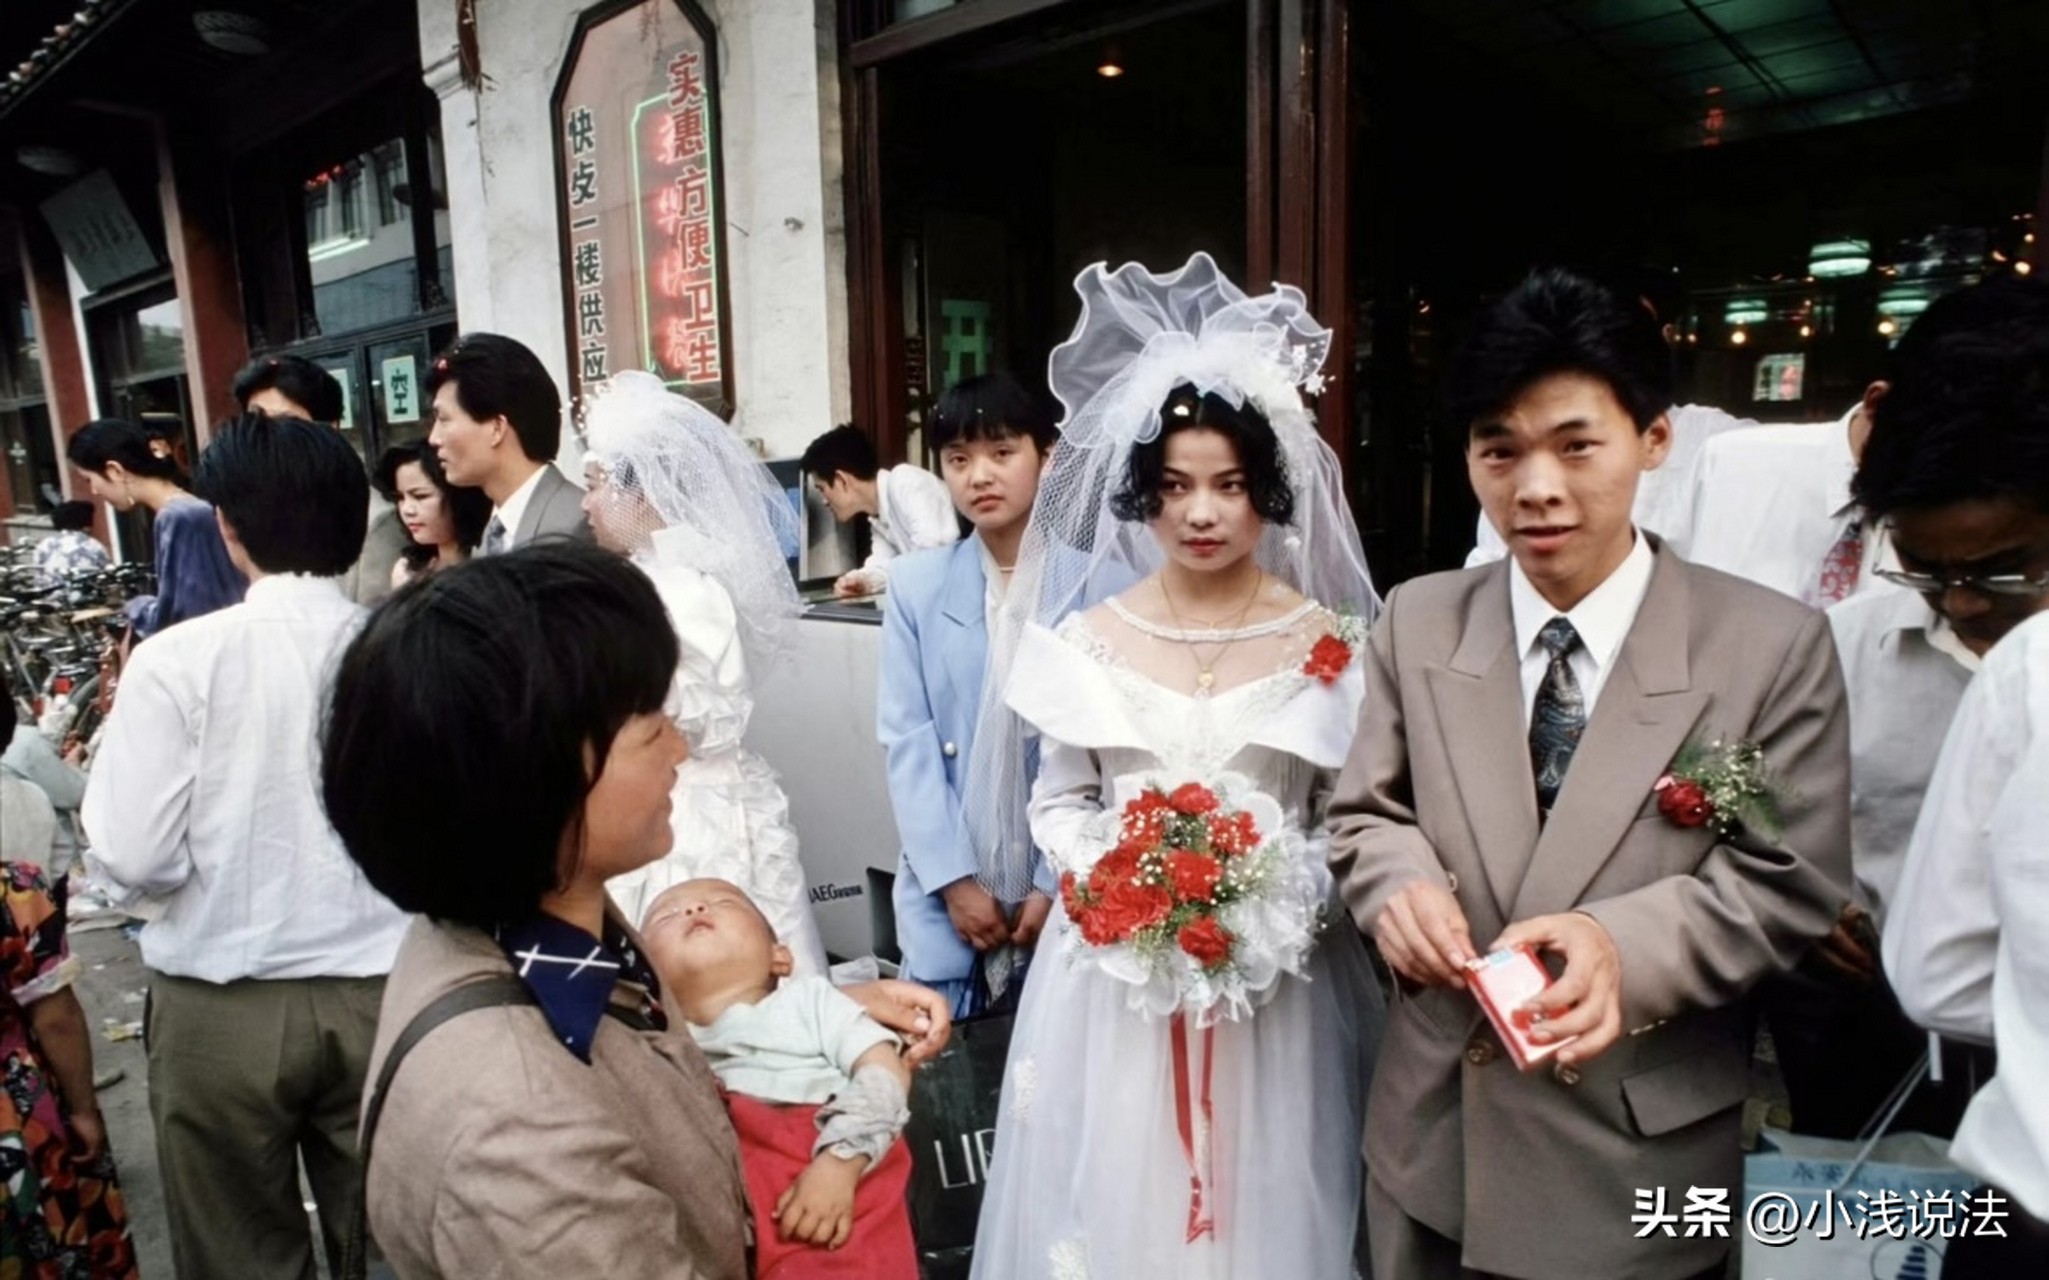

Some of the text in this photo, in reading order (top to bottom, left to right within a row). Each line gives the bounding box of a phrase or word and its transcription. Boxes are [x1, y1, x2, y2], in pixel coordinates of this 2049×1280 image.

[669, 53, 719, 381] 实惠方便卫生
[391, 368, 408, 415] 空
